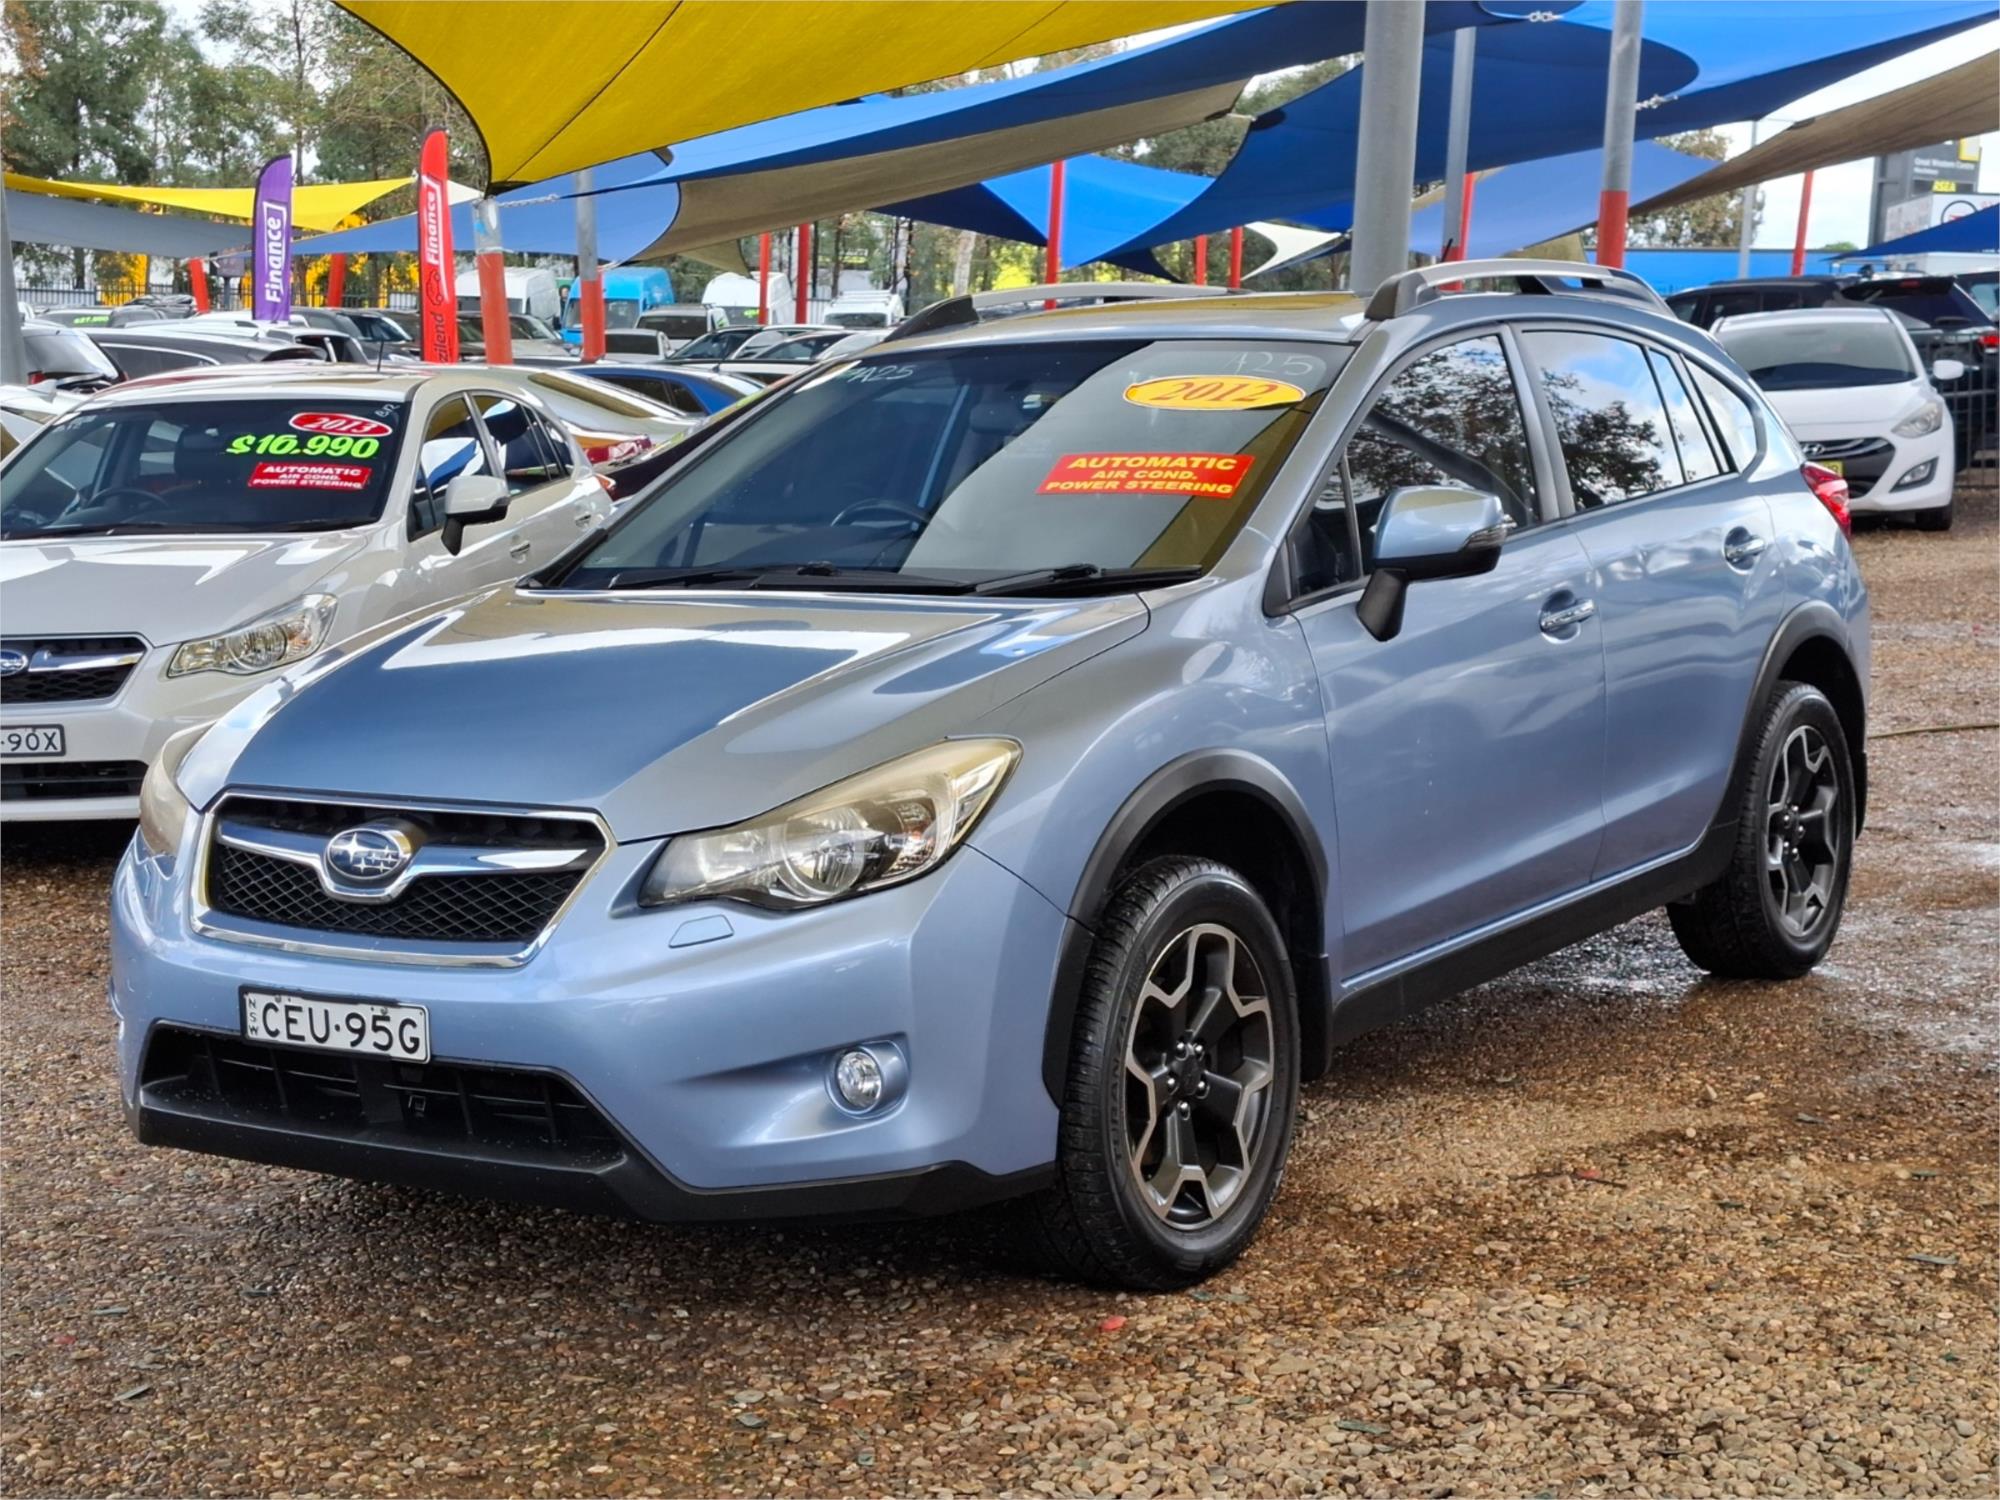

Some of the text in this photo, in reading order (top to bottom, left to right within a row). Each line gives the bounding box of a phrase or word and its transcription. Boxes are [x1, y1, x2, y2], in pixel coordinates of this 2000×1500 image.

[427, 191, 441, 267] Finance
[264, 217, 282, 304] Finance
[1151, 381, 1279, 402] 2012
[304, 416, 376, 433] 2013
[262, 465, 362, 477] AUTOMATIC
[1068, 456, 1238, 471] AUTOMATIC
[1091, 470, 1198, 480] AIR COND.
[252, 478, 363, 489] POWER STEERING
[1046, 481, 1233, 494] POWER STEERING
